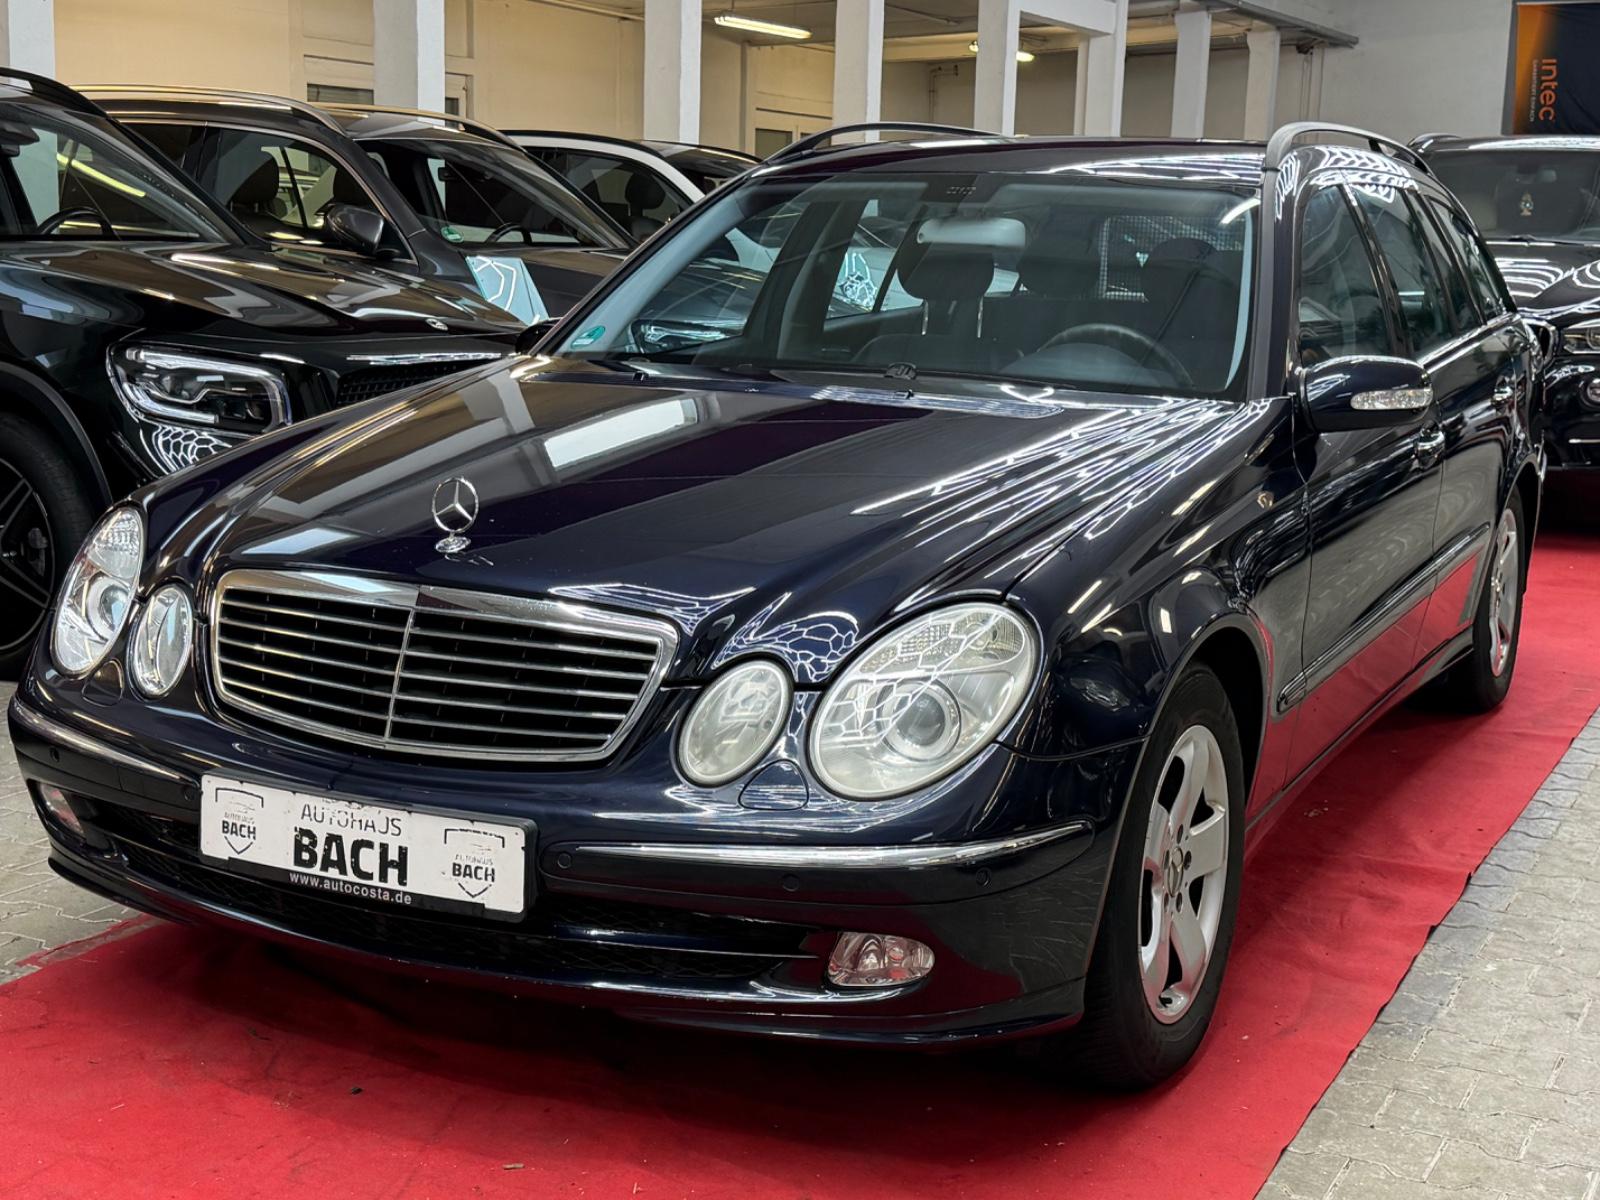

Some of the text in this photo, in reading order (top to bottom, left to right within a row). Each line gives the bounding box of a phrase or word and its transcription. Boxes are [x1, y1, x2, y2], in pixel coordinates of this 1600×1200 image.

[222, 820, 256, 841] BACH
[294, 826, 408, 887] BACH
[452, 862, 496, 883] BACH
[289, 871, 412, 905] www.autocosta.de
